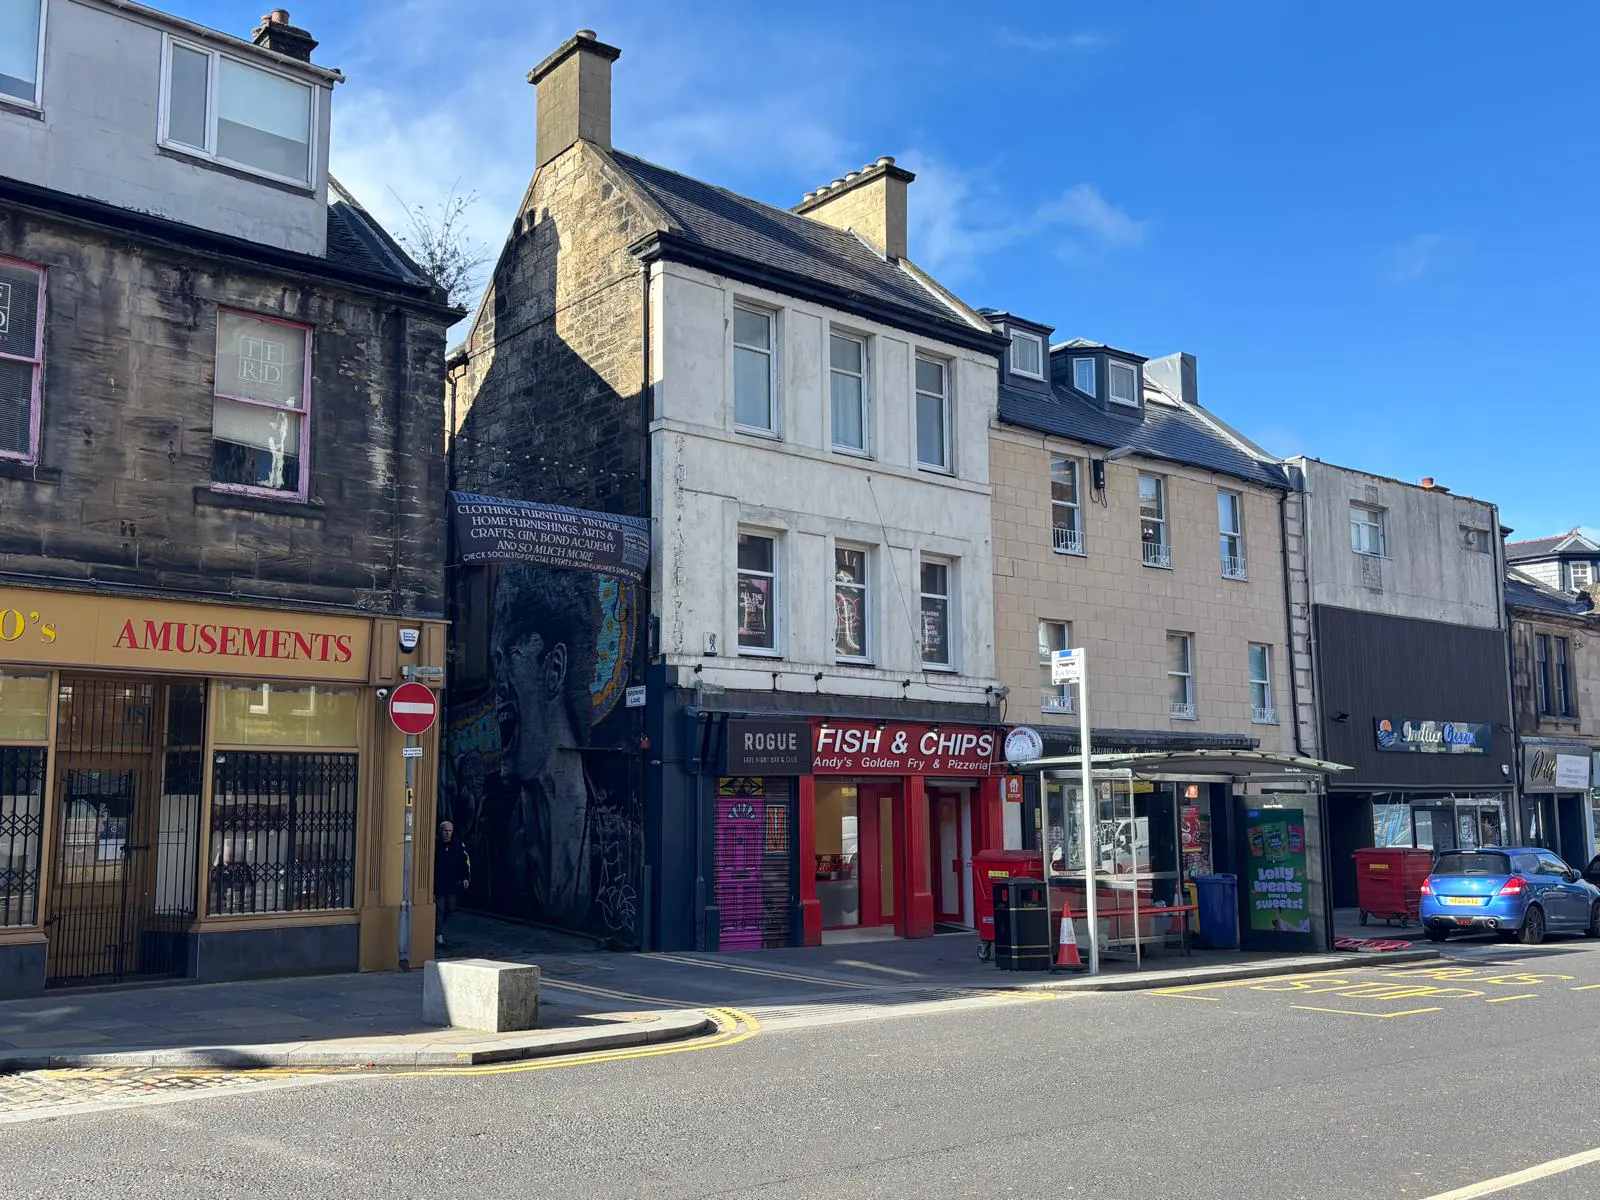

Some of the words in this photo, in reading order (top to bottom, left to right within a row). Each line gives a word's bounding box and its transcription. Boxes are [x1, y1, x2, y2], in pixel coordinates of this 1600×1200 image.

[457, 504, 520, 517] CLOTHING,
[521, 508, 581, 525] FURNITURE,
[582, 517, 623, 532] VINTAGE,
[472, 516, 508, 526] HOME
[509, 517, 580, 536] FURNISHINGS,
[581, 527, 606, 540] ARTS
[607, 532, 615, 541] &
[470, 528, 516, 539] CRAFTS,
[517, 530, 538, 542] GIN,
[540, 533, 570, 546] BOND
[571, 538, 617, 553] ACADEMY
[463, 551, 486, 561] CHECK
[487, 550, 514, 558] SOCIALS
[524, 553, 549, 564] SPECIAL
[551, 556, 573, 567] EVENTS
[497, 540, 517, 550] AND
[517, 542, 533, 553] SO
[533, 545, 566, 558] MUCH
[566, 549, 594, 562] MORE
[112, 618, 352, 663] AMUSEMENTS
[744, 732, 797, 751] ROGUE
[816, 728, 882, 753] FISH
[890, 730, 909, 755] &
[919, 732, 993, 757] CHIPS
[1067, 745, 1082, 754] AFR
[813, 756, 852, 770] Andy's
[861, 757, 900, 768] Golden
[907, 758, 926, 771] Fry
[932, 759, 941, 769] &
[948, 759, 989, 770] Pizzeria
[1258, 866, 1295, 881] Lolly
[1253, 880, 1302, 893] treats
[1255, 898, 1304, 910] sweets!
